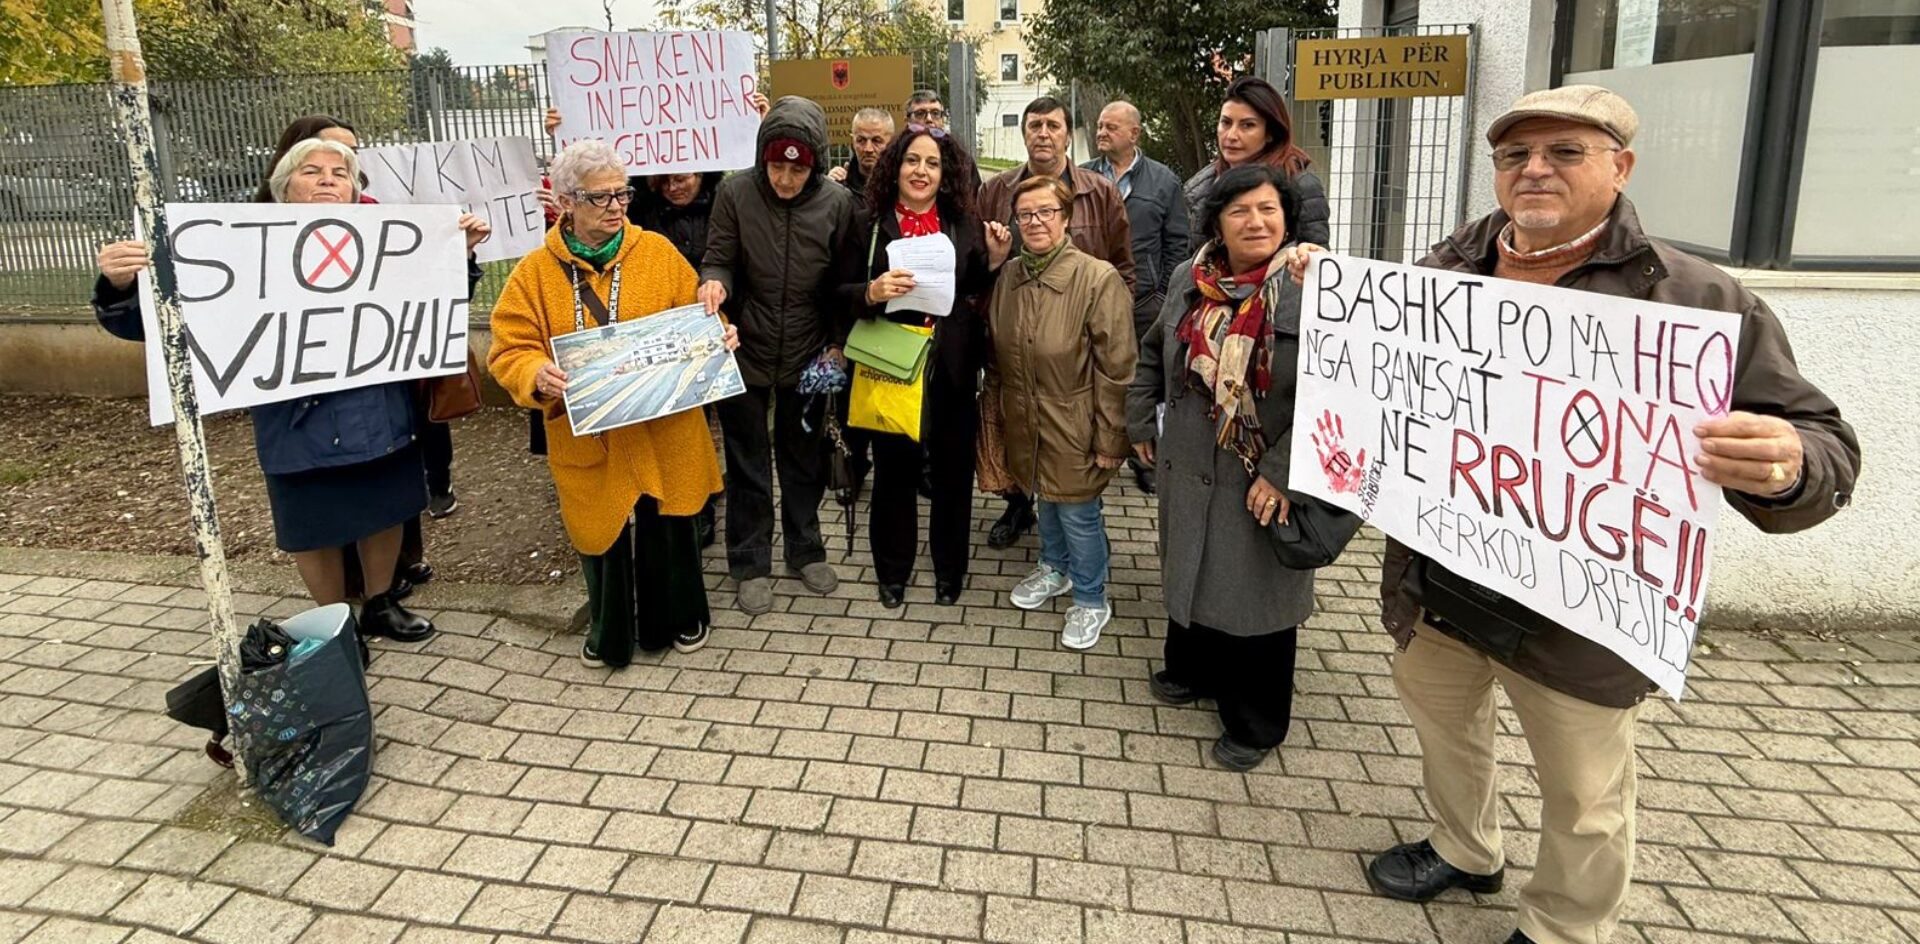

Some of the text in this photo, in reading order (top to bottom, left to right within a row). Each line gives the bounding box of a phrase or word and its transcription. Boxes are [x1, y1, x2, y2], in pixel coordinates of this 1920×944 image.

[653, 33, 726, 79] KENI
[1313, 42, 1449, 70] HYRJA PËR
[1319, 70, 1441, 91] PUBLIKUN
[586, 73, 760, 132] INFORMUAR
[170, 218, 423, 303] STOP
[184, 298, 469, 399] VJEDHJE
[1498, 300, 1552, 367] PO
[1567, 313, 1623, 389] NA
[1634, 314, 1733, 417] HEQ
[1303, 329, 1699, 512] NGA BANESAT TONA
[1381, 407, 1706, 622] NË RRUGË!!
[1416, 496, 1537, 590] KËRKOJ
